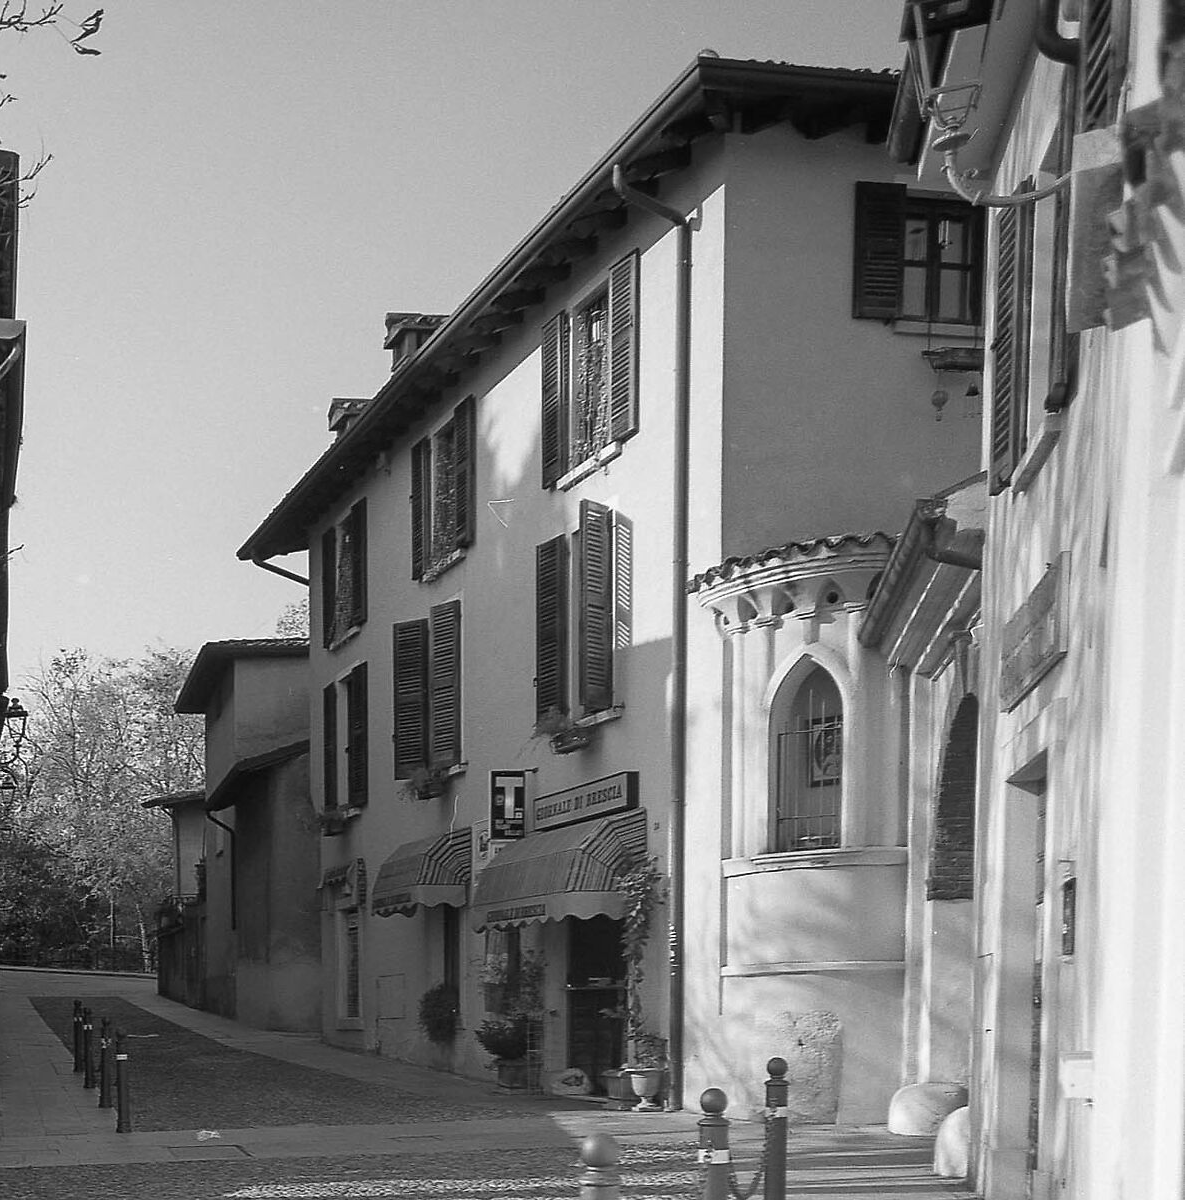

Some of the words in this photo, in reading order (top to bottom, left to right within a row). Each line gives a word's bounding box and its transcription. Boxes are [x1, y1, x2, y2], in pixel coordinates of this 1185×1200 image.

[495, 776, 524, 819] T
[536, 799, 571, 821] GIORNALE
[574, 795, 584, 811] DI
[585, 784, 623, 807] BRESCIA
